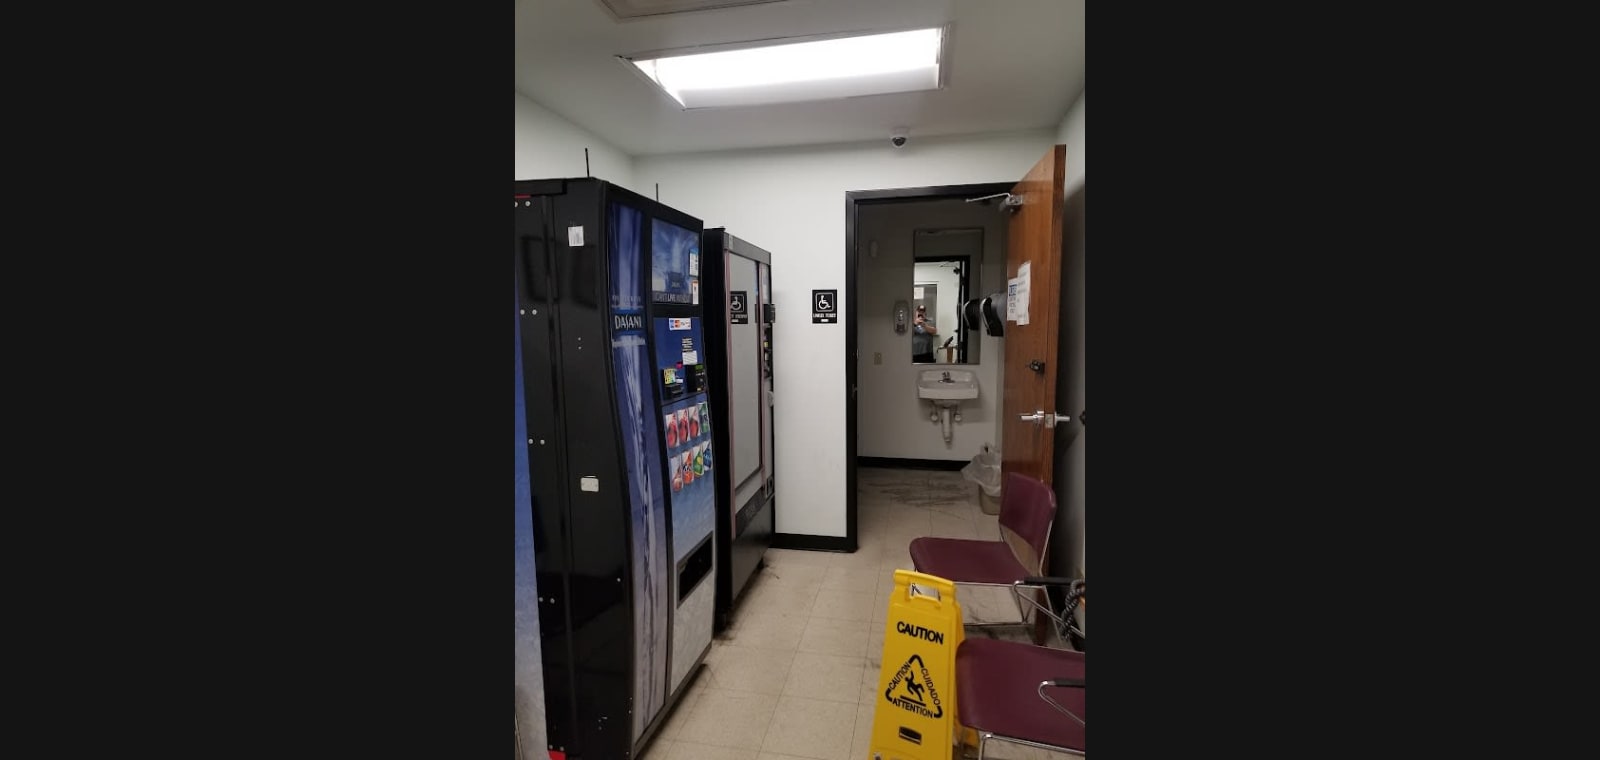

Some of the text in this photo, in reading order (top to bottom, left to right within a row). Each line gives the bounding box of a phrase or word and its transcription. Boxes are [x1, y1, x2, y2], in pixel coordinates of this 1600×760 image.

[614, 314, 642, 331] DASANI
[897, 621, 944, 646] CAUTION
[888, 661, 911, 691] CAUTION
[921, 667, 941, 706] CUIDADO
[892, 698, 934, 719] ATTENTION
